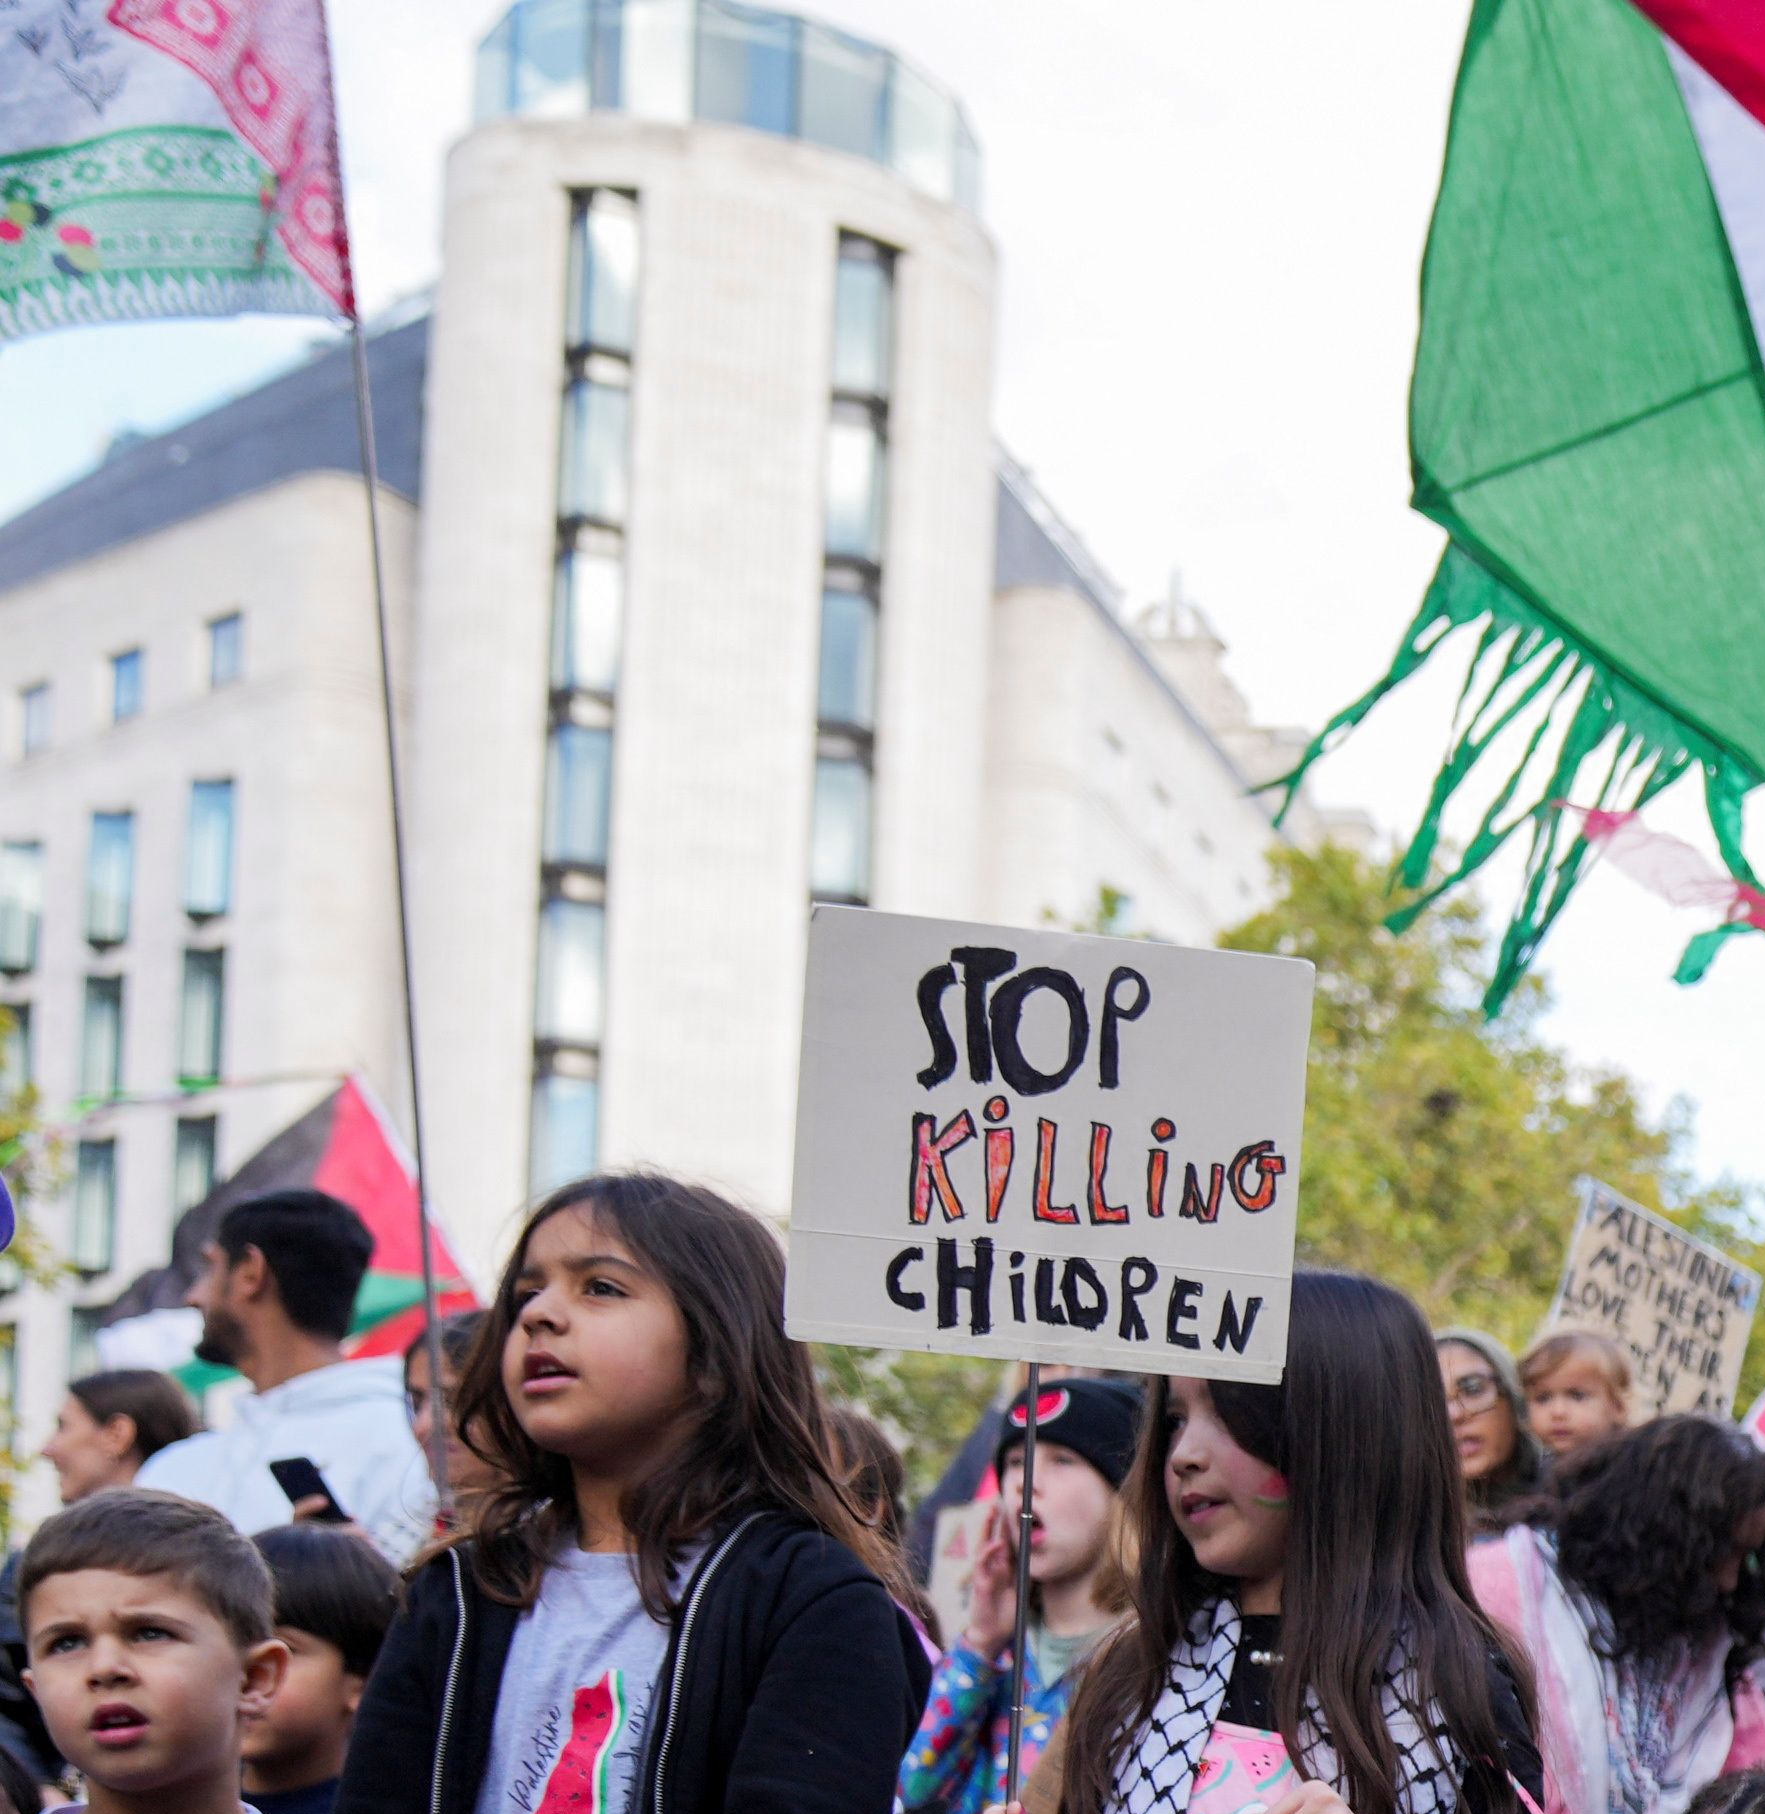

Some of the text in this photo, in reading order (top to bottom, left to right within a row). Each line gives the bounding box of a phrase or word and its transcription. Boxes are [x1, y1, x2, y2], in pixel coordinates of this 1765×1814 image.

[916, 946, 1150, 1095] STOP
[1564, 1268, 1626, 1324] LOVE
[1655, 1320, 1721, 1381] THEIR
[1588, 1246, 1725, 1341] MOTHERS
[507, 1705, 560, 1812] Palestine
